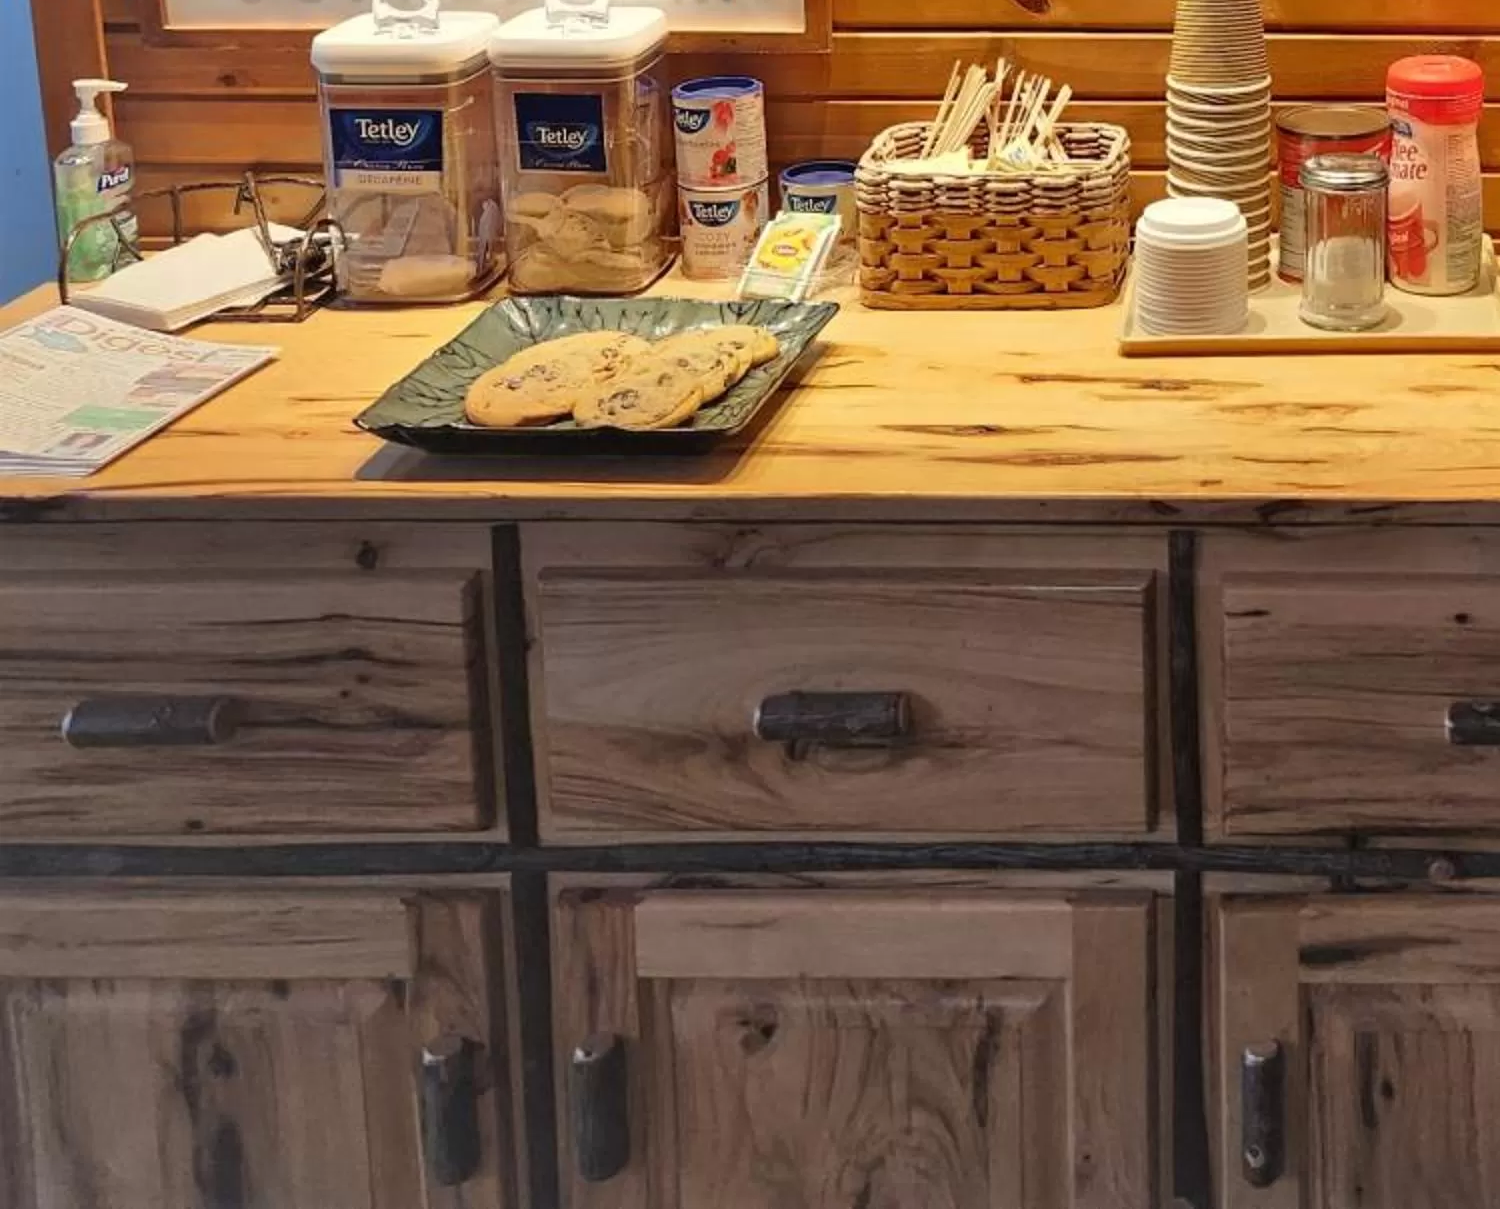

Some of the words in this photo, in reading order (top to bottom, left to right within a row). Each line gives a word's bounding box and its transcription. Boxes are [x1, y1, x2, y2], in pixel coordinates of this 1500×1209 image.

[354, 118, 421, 146] Tetley
[535, 126, 589, 150] Tetley
[692, 202, 735, 222] Tetley
[791, 195, 833, 212] Tetley
